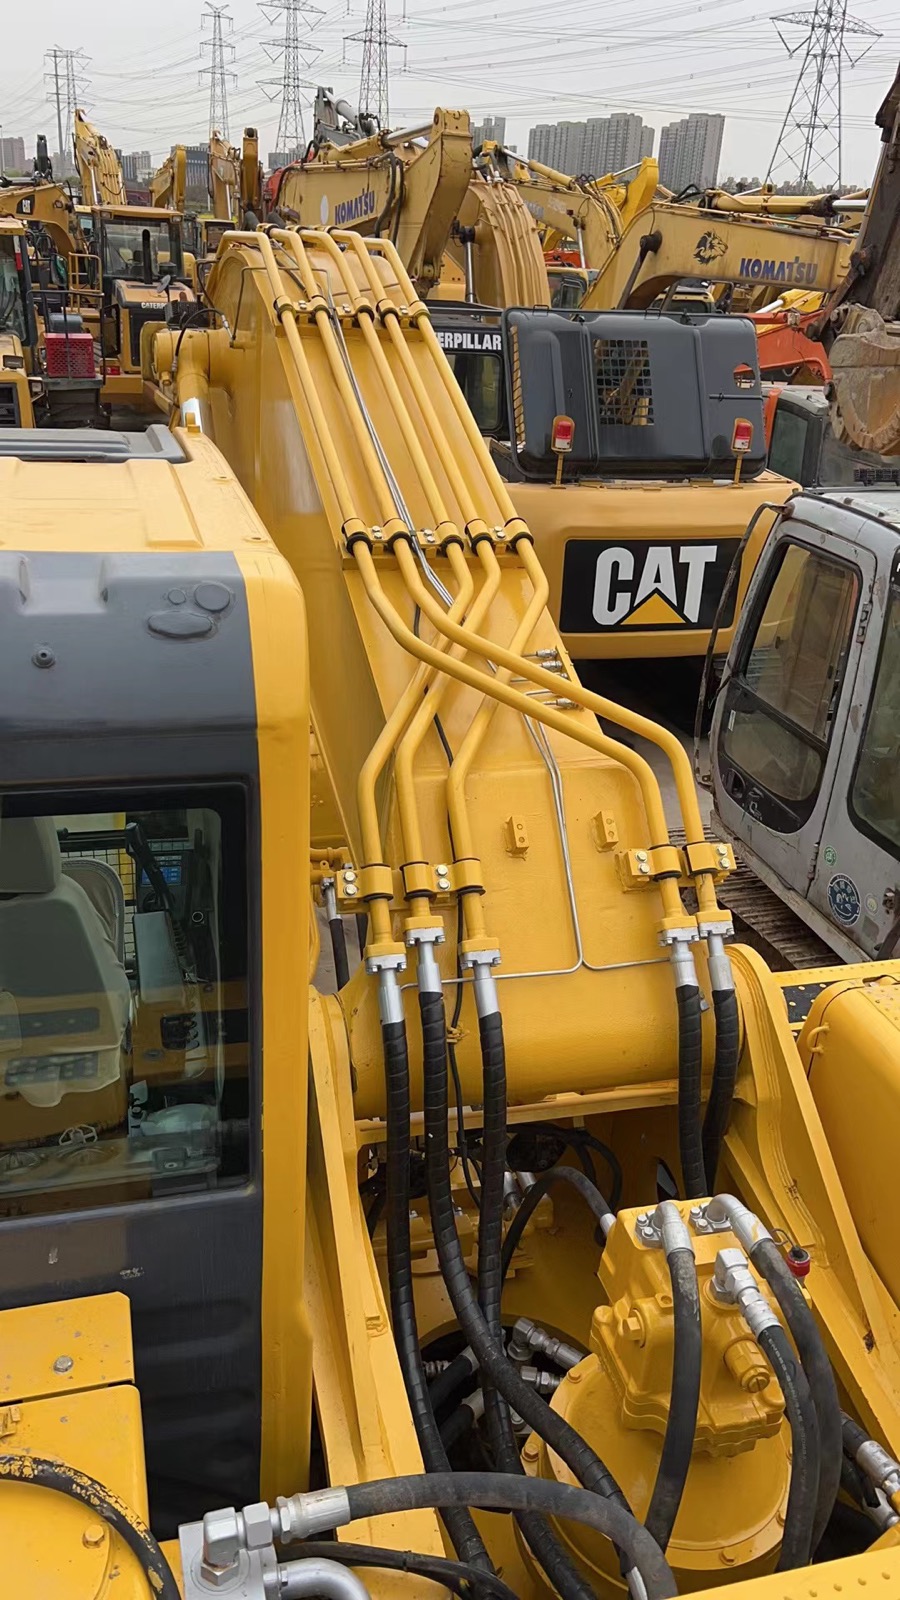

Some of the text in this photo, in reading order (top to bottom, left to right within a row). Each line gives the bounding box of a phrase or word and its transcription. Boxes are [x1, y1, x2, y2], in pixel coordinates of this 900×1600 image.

[335, 188, 375, 225] KOMATSU
[739, 256, 818, 284] KOMATSU
[434, 332, 502, 350] ERPILLAR
[592, 545, 718, 625] CAT
